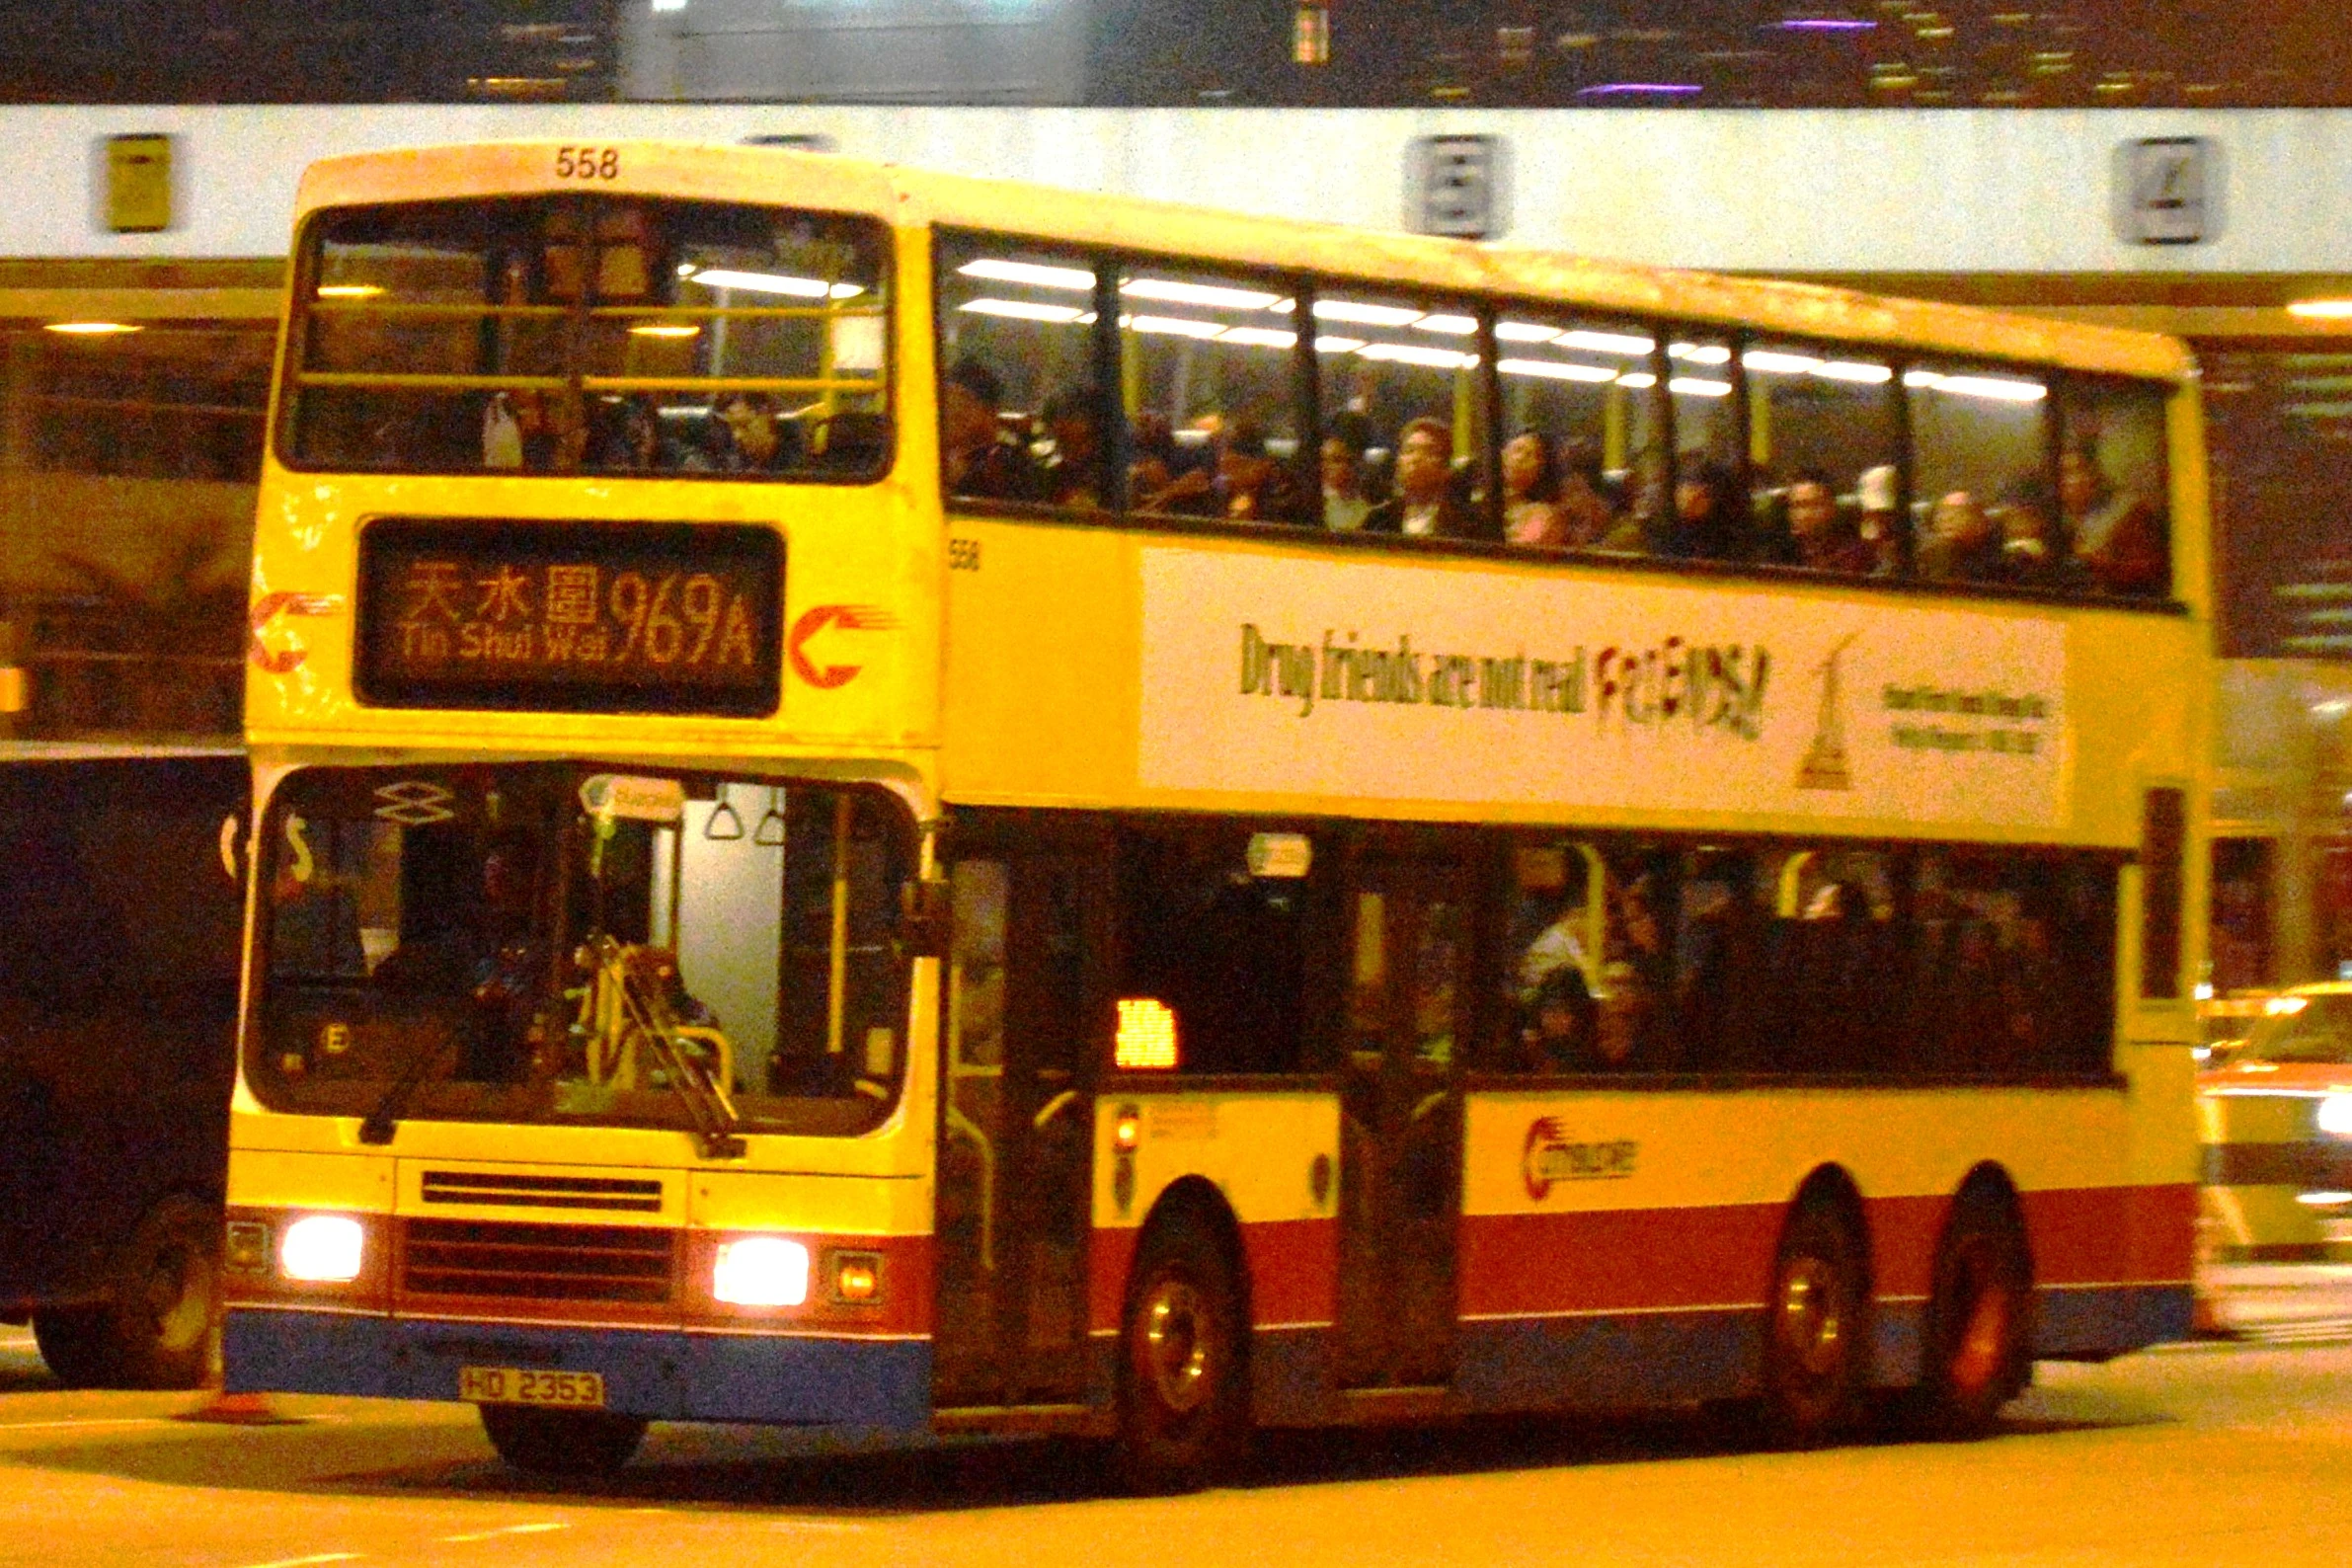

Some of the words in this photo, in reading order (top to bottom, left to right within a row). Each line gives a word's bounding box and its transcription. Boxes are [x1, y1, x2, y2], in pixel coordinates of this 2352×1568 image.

[555, 146, 619, 180] 558
[949, 539, 980, 572] 558
[610, 570, 754, 666] 969A
[401, 620, 448, 658] Tin
[459, 621, 533, 660] Shui
[542, 623, 609, 662] Wai
[465, 1370, 507, 1398] HD
[517, 1372, 599, 1402] 2353
